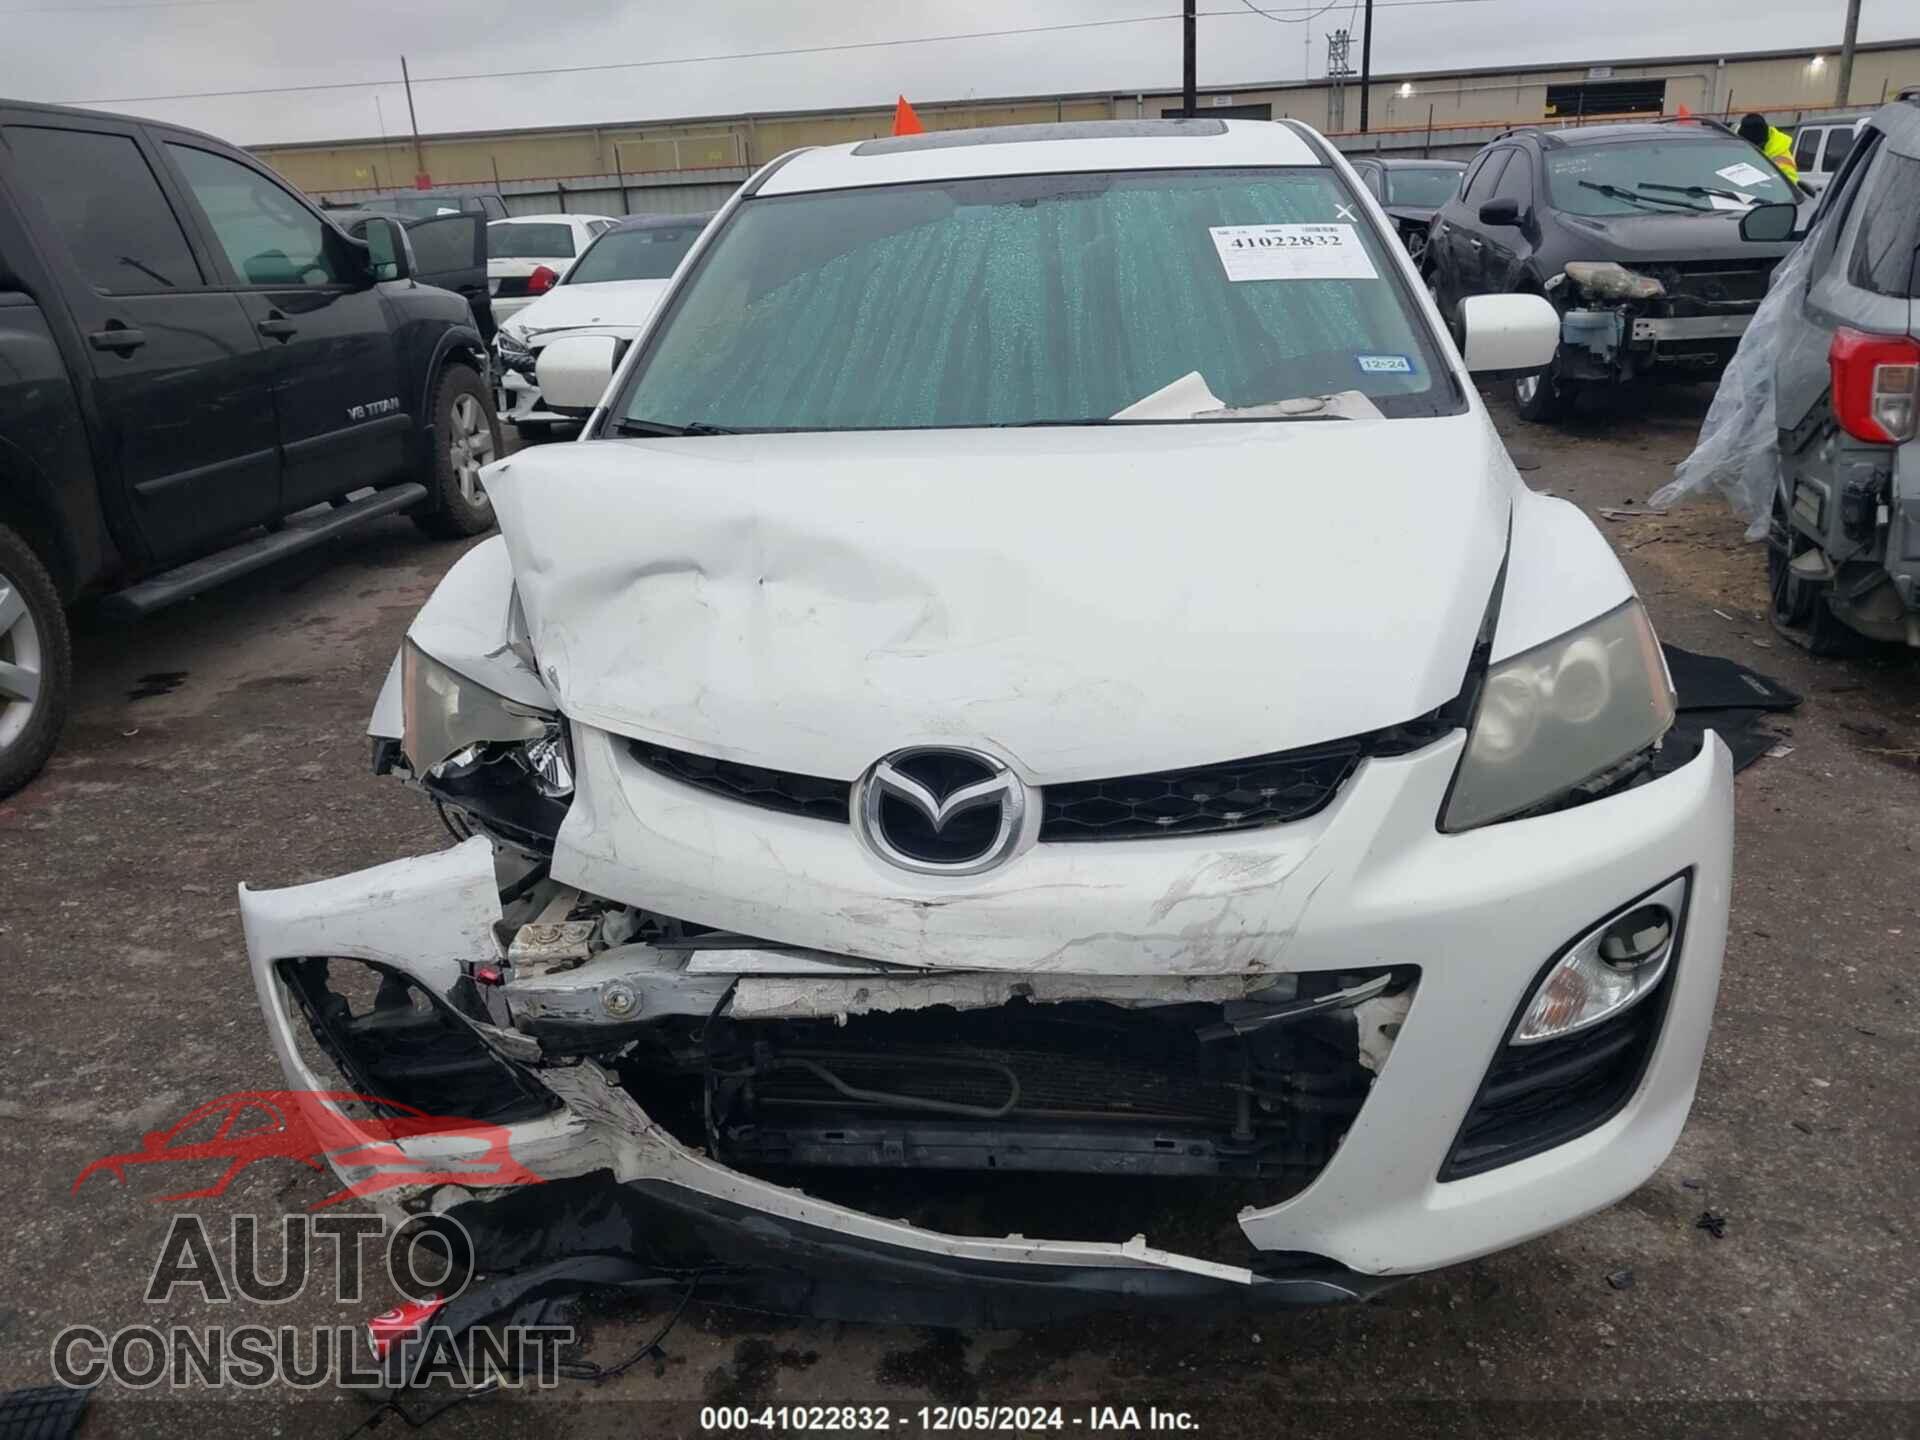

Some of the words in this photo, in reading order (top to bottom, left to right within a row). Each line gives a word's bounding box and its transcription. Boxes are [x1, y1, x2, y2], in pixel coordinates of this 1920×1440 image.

[1231, 235, 1344, 249] 41022832
[346, 405, 365, 420] V8
[366, 396, 400, 415] TITAN
